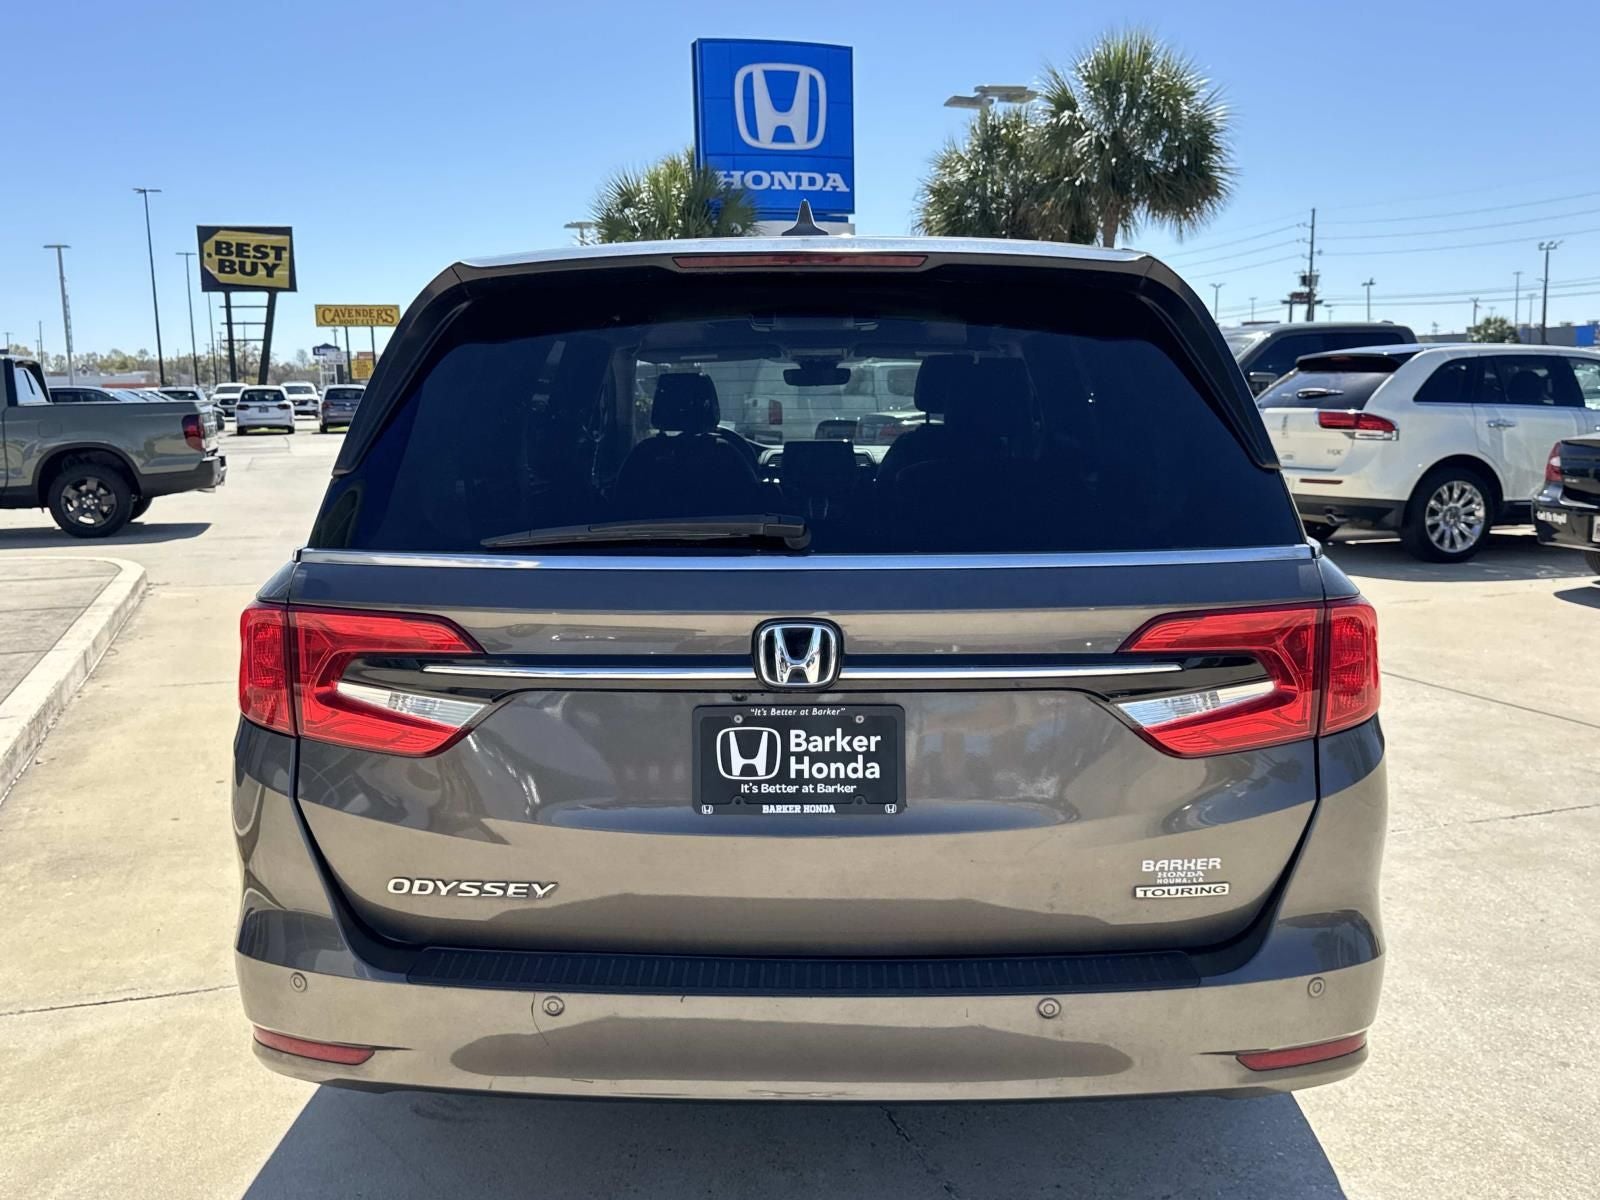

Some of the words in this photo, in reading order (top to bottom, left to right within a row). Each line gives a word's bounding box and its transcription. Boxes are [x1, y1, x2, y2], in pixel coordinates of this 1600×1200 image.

[714, 170, 850, 193] HONDA
[214, 240, 288, 262] BEST
[218, 258, 281, 279] BUY
[321, 307, 395, 324] CAVENDER'S
[770, 707, 797, 716] Better
[800, 707, 809, 716] at
[789, 728, 881, 752] Barker
[789, 754, 880, 779] Honda
[740, 782, 759, 793] It's
[761, 783, 799, 793] Better
[801, 784, 815, 793] at
[817, 783, 857, 793] Barker
[762, 804, 801, 814] BARKER
[803, 804, 836, 814] HONDA
[1142, 858, 1222, 872] BARKER
[1157, 870, 1204, 878] HONDA
[387, 877, 559, 899] ODYSSEY
[1138, 885, 1227, 897] TOURING
